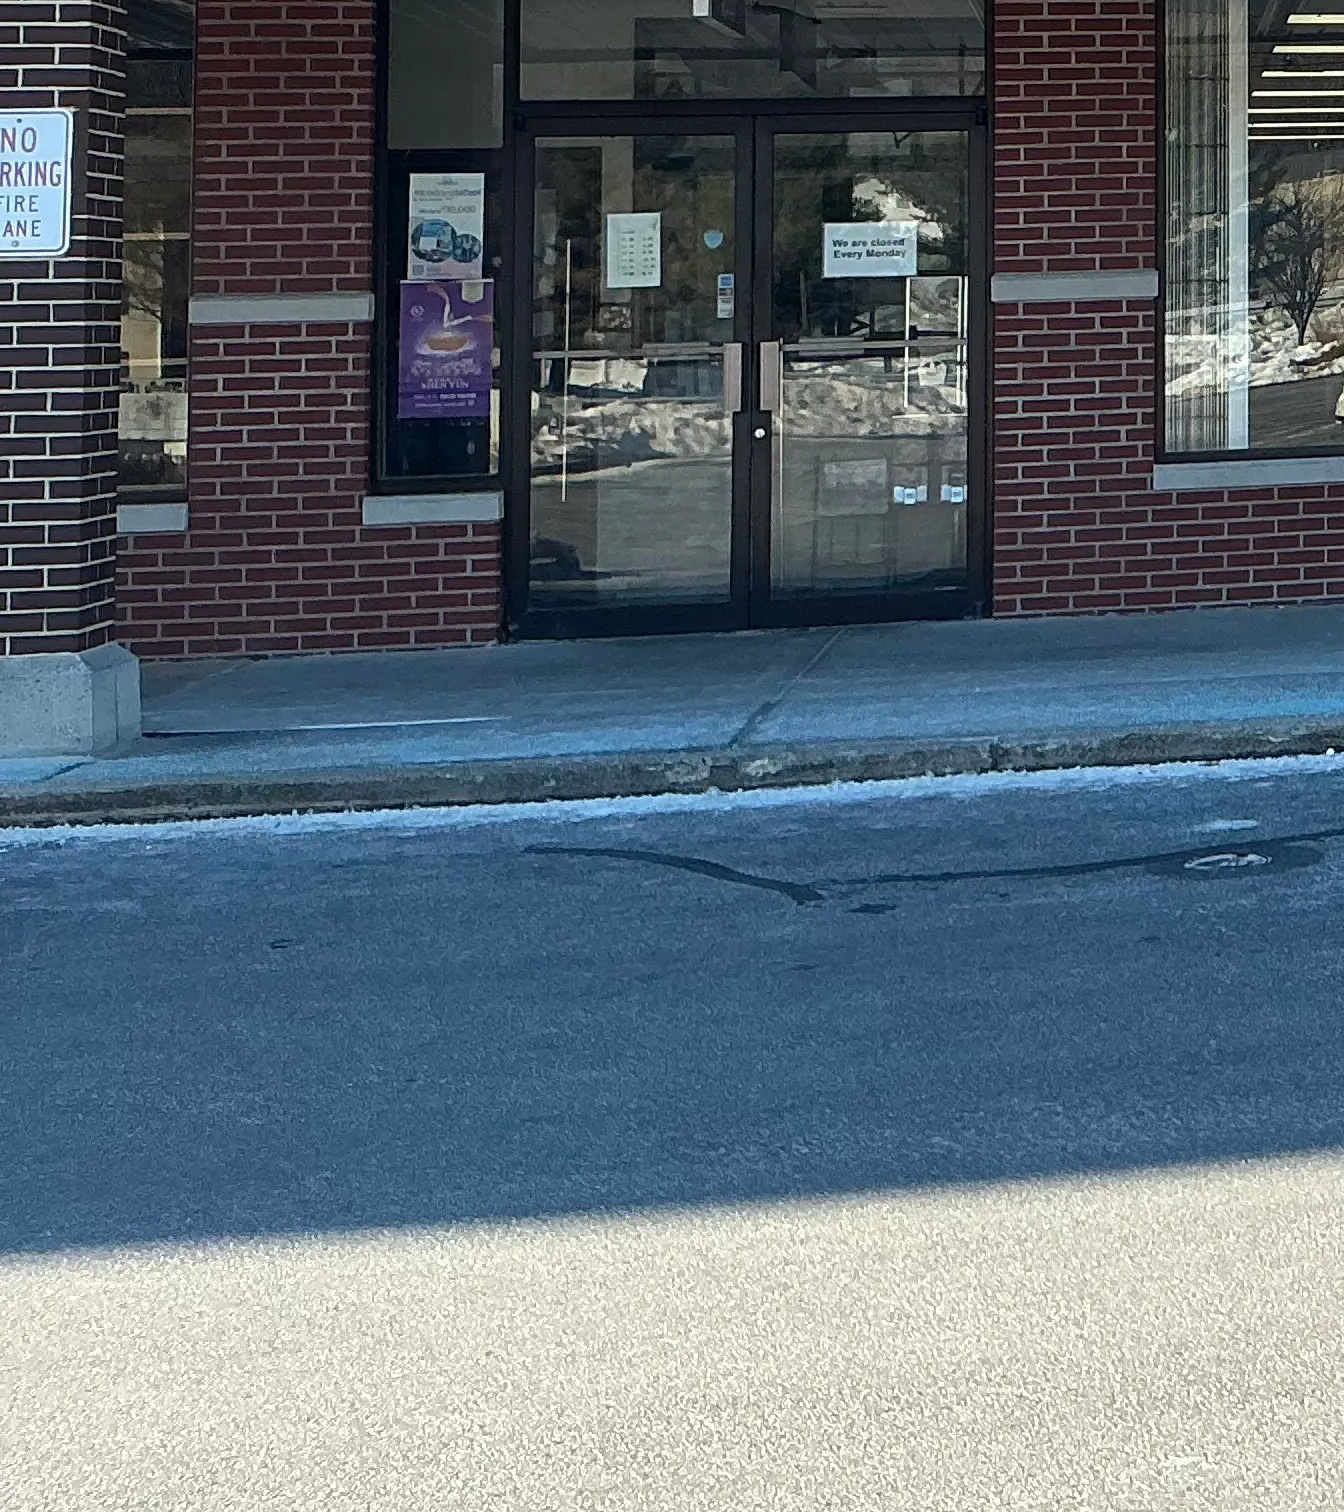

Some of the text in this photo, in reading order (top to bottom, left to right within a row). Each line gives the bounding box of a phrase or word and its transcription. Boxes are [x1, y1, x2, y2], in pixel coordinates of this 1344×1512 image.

[0, 126, 38, 154] NO
[0, 160, 62, 188] RKING
[2, 219, 42, 238] ANE
[831, 237, 906, 248] We are closed
[833, 248, 907, 260] Every Monday
